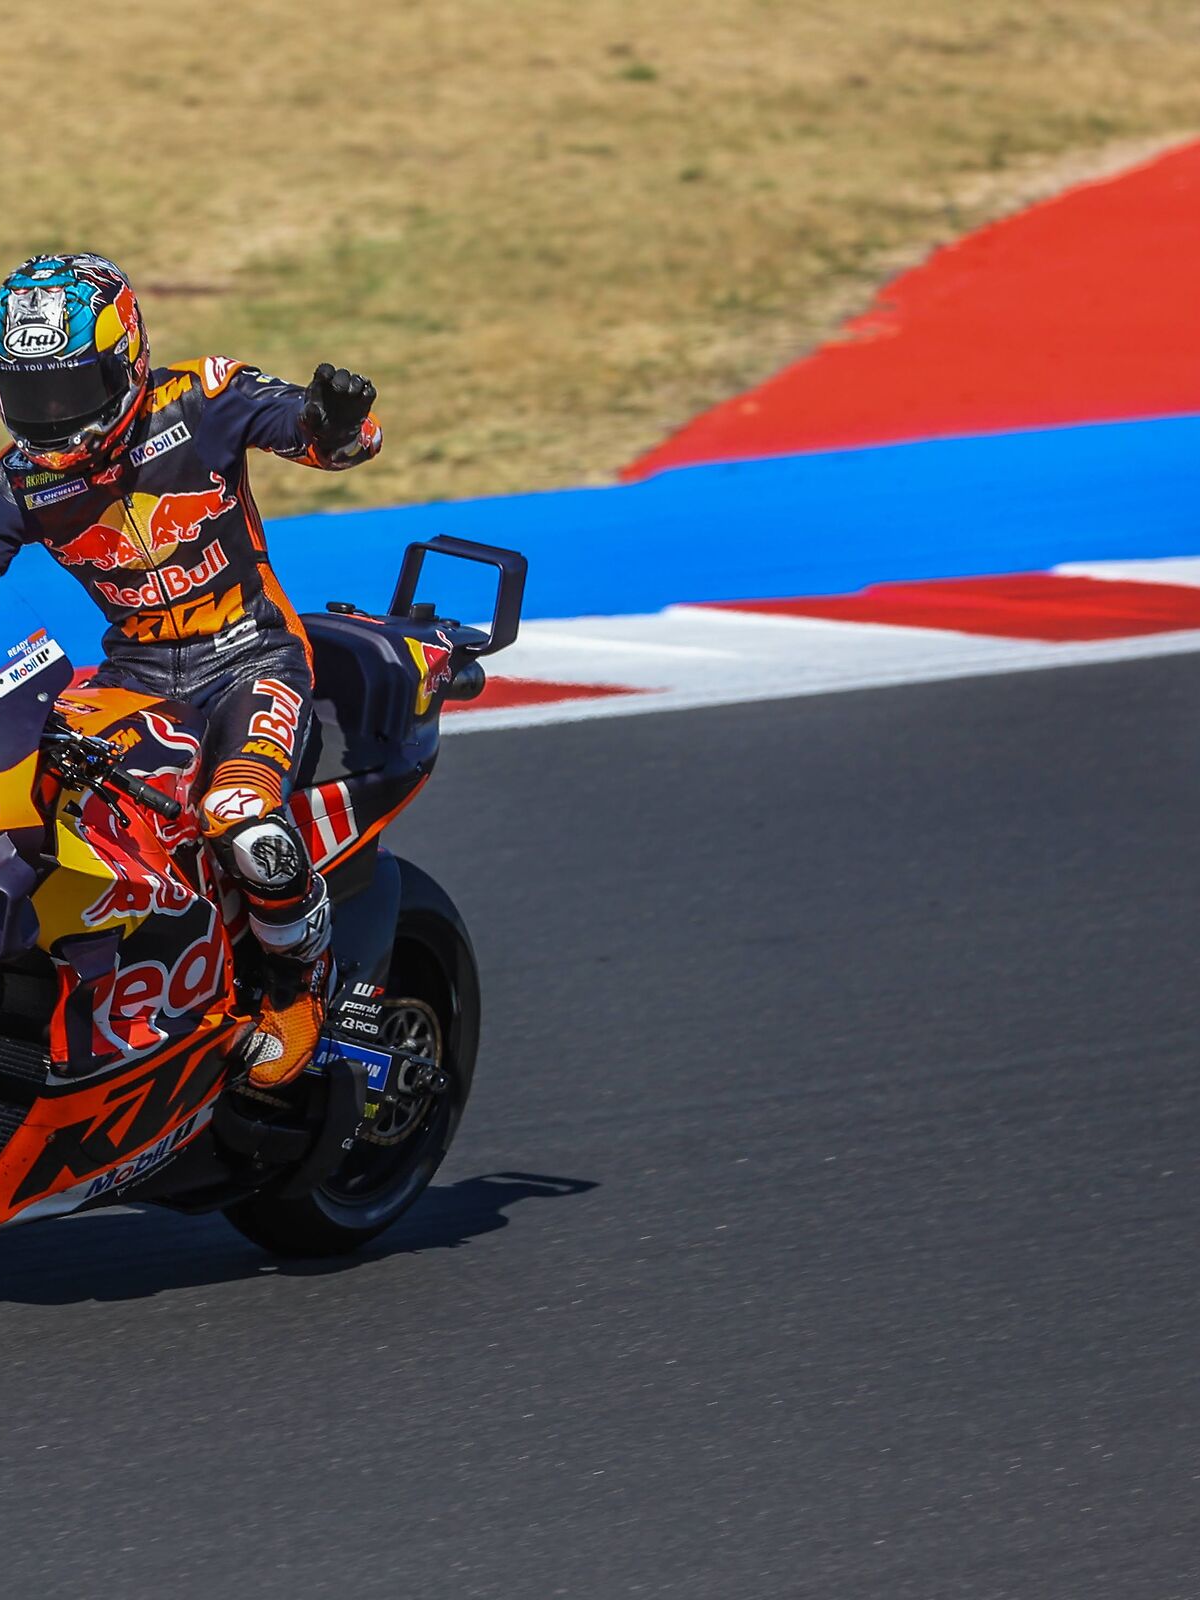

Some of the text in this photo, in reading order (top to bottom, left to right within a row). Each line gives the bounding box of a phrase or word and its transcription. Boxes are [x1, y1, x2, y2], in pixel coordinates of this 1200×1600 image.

[31, 269, 56, 280] 26
[9, 329, 57, 348] Arai
[24, 363, 43, 371] YOU
[47, 359, 79, 370] WINGS
[131, 433, 173, 463] Mobil
[43, 484, 81, 501] MICHELIN
[94, 538, 230, 608] Red Bull
[121, 583, 245, 643] KTM
[7, 638, 29, 658] READY
[9, 657, 39, 683] Mobil
[248, 678, 304, 756] Bull
[241, 739, 292, 771] KTM
[352, 982, 386, 999] WP
[355, 1020, 379, 1035] RCB
[8, 1032, 232, 1209] KTM
[84, 1135, 171, 1199] Mobil
